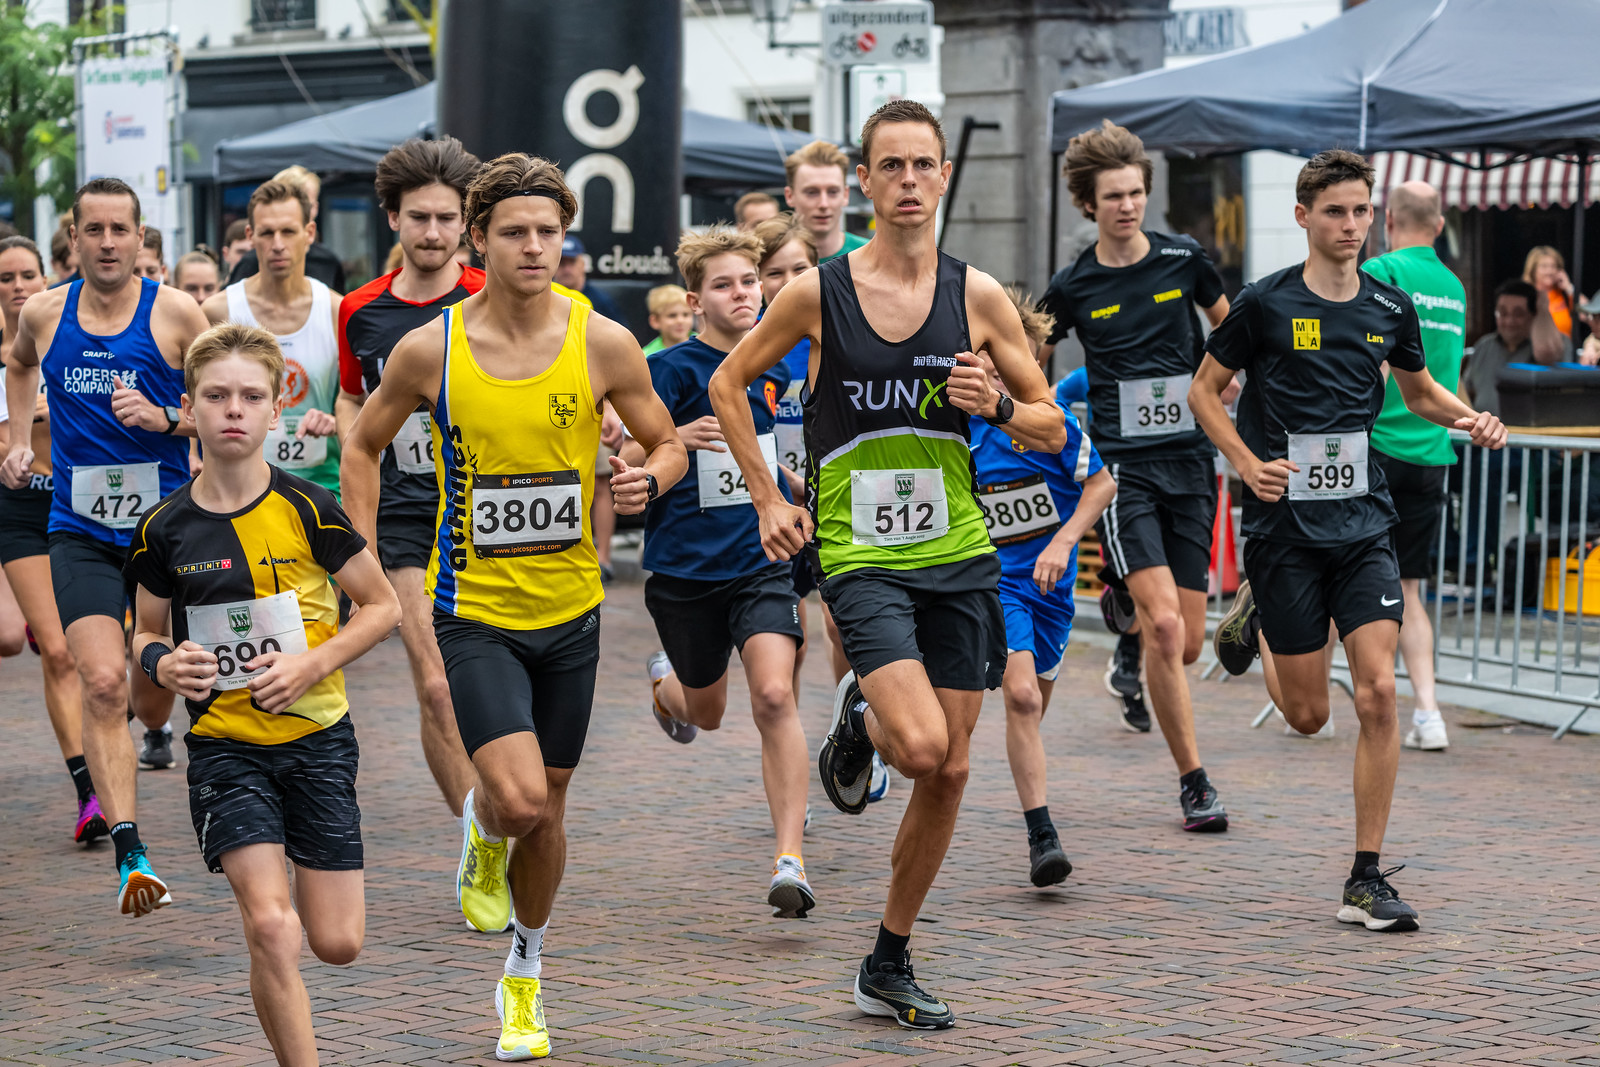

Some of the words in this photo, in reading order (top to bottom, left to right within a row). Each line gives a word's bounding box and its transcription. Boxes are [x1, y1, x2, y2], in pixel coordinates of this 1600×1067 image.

[1374, 293, 1397, 311] CRAFT
[1367, 333, 1384, 344] Lars
[83, 351, 107, 359] CRAFT
[65, 367, 119, 382] LOPERS
[842, 379, 947, 420] RUNX
[1138, 403, 1181, 426] 359
[278, 441, 304, 460] 82
[1308, 464, 1354, 489] 599
[91, 494, 142, 519] 472
[446, 424, 468, 572] achilles
[476, 496, 579, 534] 3804
[875, 503, 934, 534] 512
[493, 543, 562, 555] www.ipicosports.com
[176, 561, 221, 575] SPRINT
[462, 841, 478, 888] HOKA
